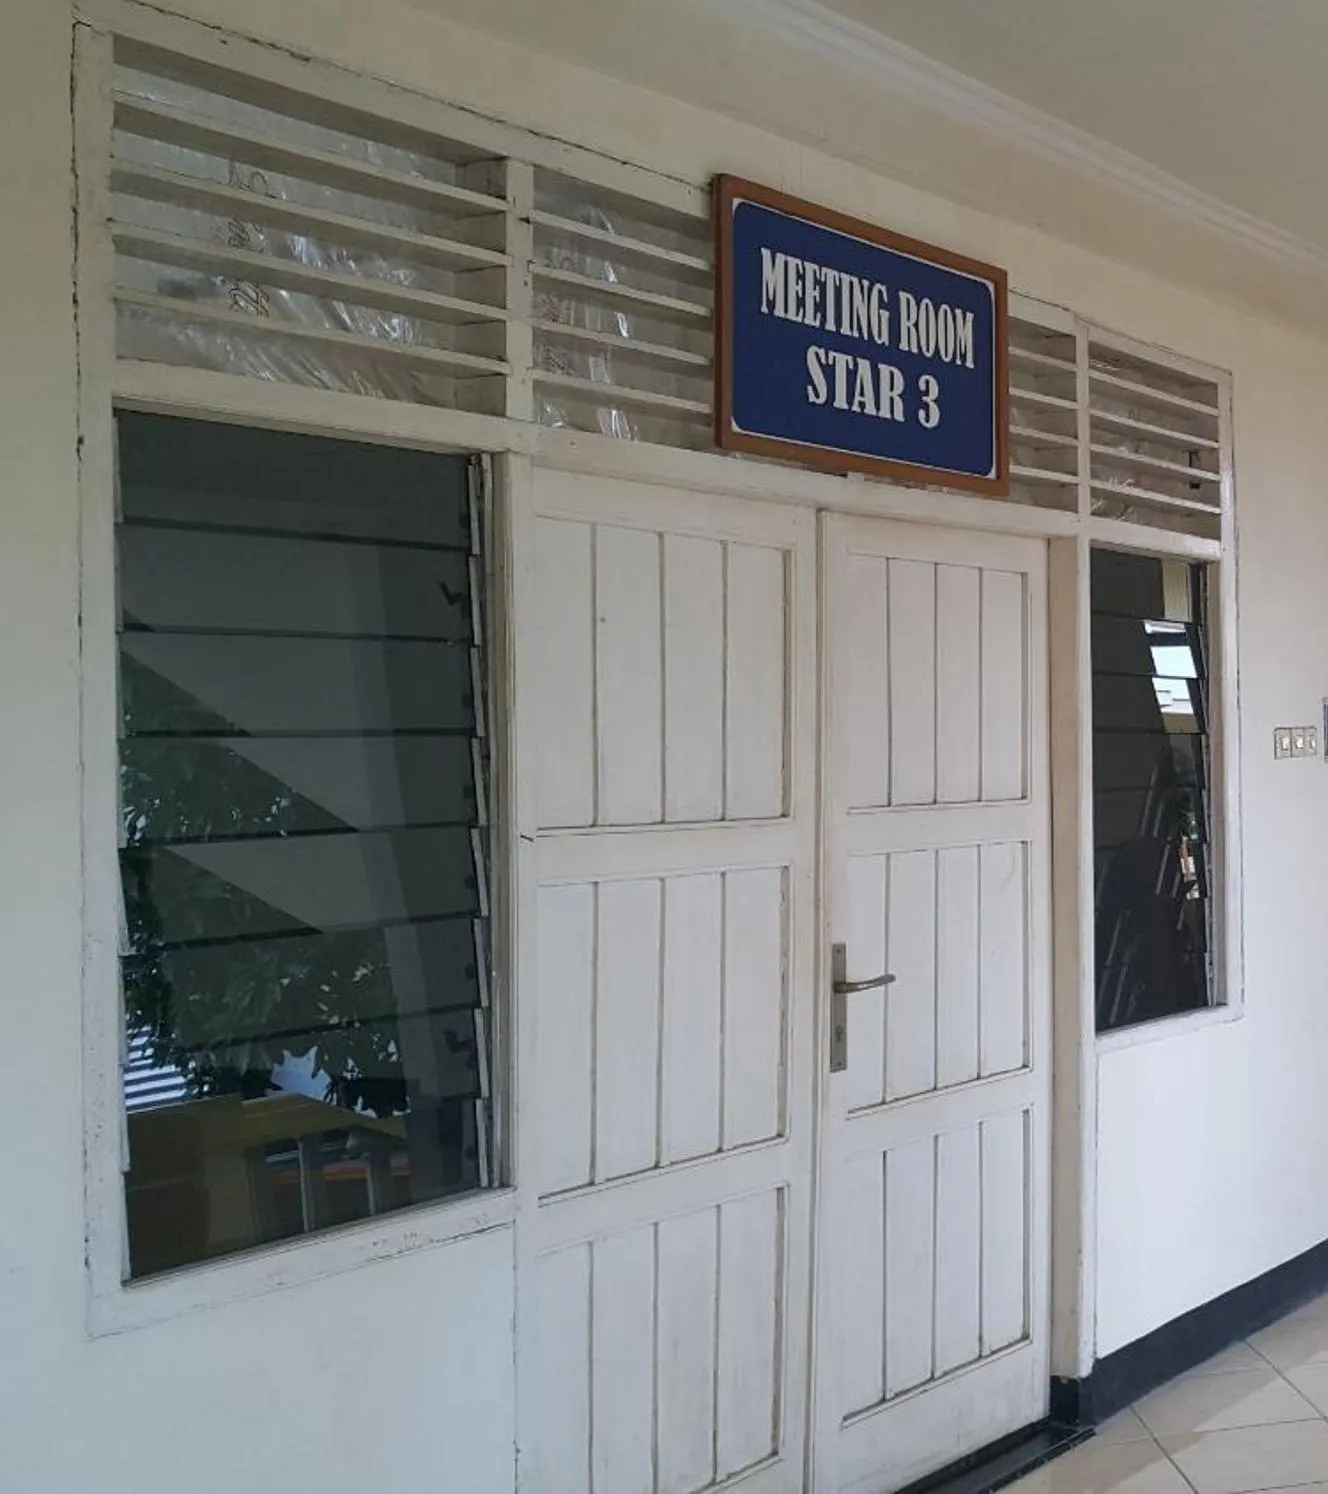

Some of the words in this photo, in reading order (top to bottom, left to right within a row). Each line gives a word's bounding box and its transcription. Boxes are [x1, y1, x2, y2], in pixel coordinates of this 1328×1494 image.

[760, 247, 890, 346] MEETING
[898, 290, 975, 369] ROOM
[806, 345, 905, 422] STAR
[918, 374, 940, 428] 3
